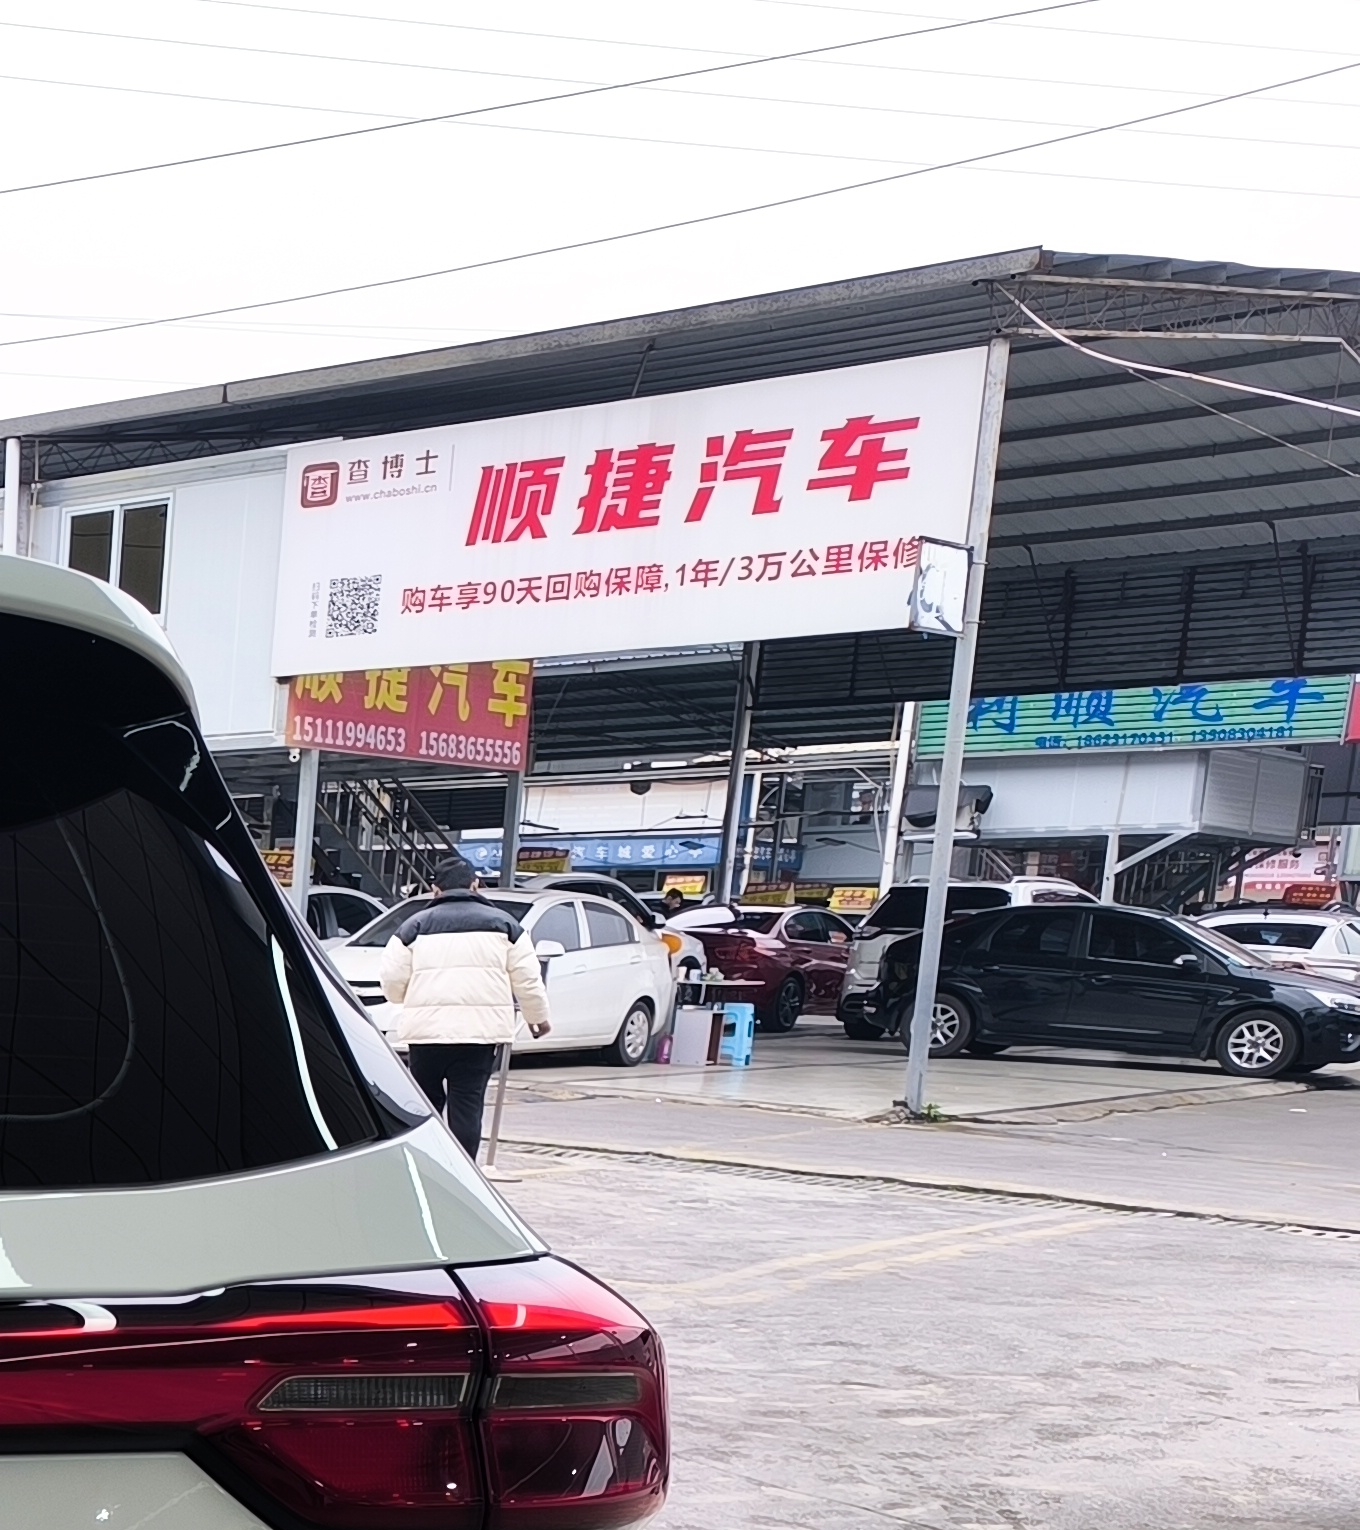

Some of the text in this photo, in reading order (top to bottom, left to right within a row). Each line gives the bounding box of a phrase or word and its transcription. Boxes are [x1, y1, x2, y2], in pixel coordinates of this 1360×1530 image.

[347, 449, 439, 485] 查博士
[465, 415, 920, 546] 顺捷汽车
[345, 484, 437, 502] www.chaboshi.cn
[293, 715, 521, 766] 15111994653 15683655556
